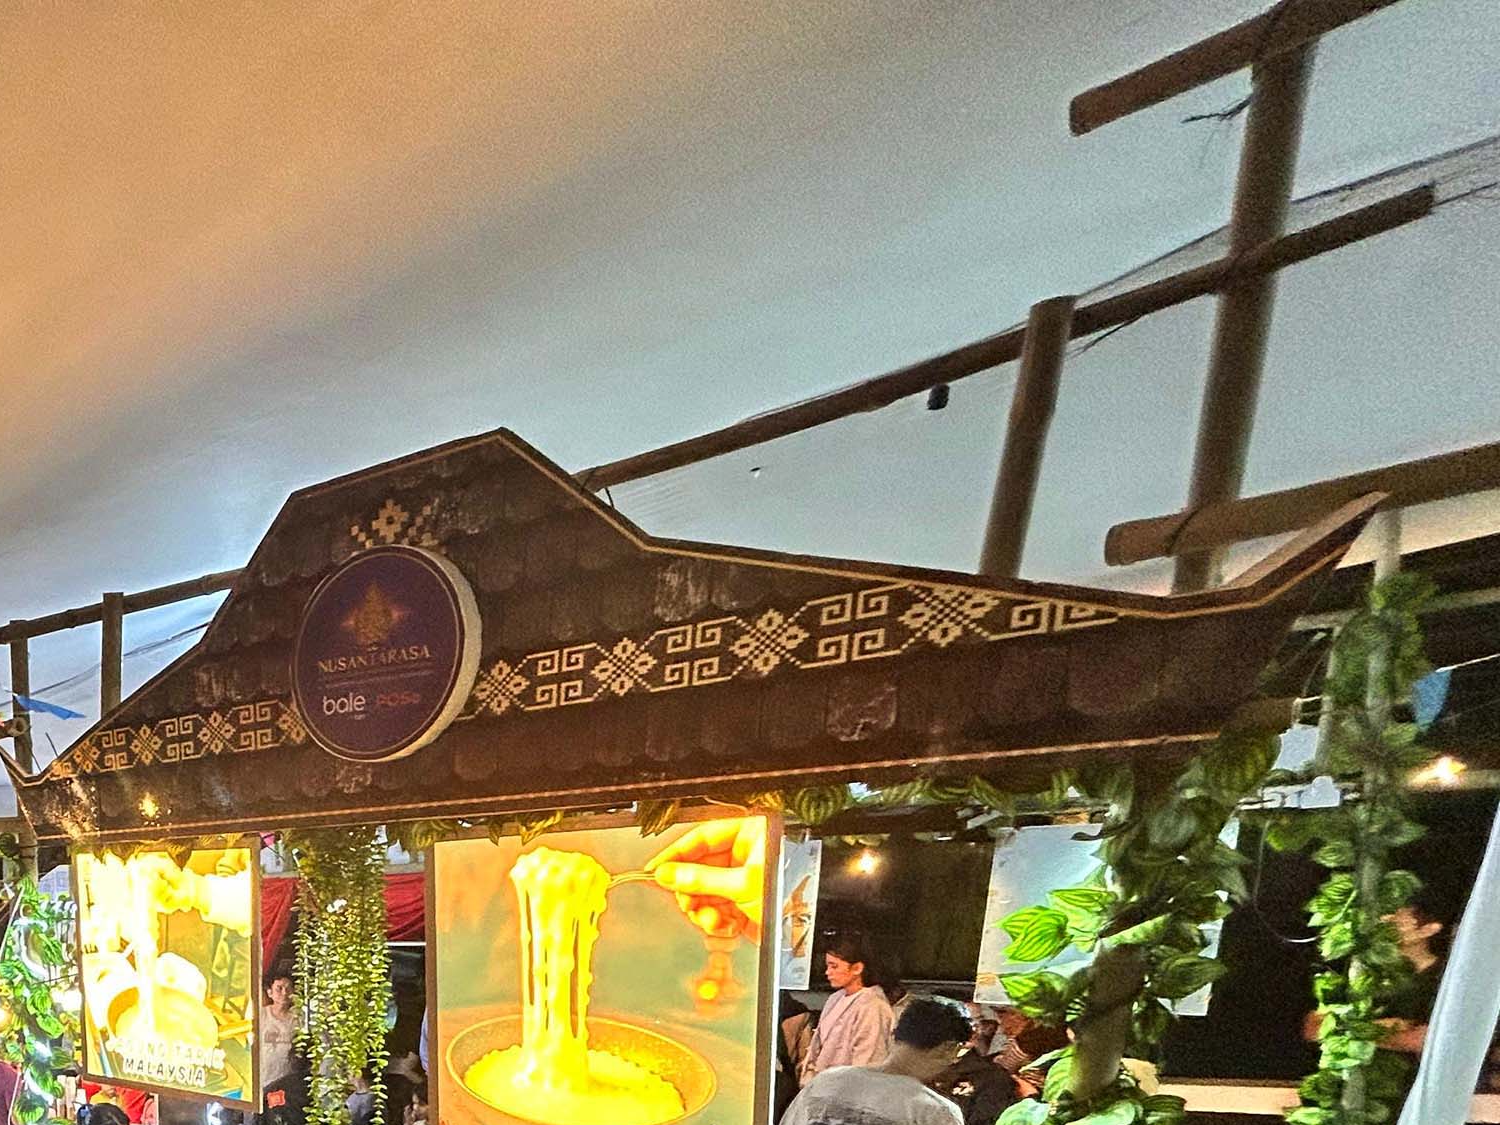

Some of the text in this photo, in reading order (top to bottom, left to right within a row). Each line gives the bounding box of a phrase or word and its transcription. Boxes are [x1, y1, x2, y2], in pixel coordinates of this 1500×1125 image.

[318, 645, 432, 673] NUSANTARASA
[323, 692, 366, 715] bale
[124, 1058, 204, 1082] MALAYSIA
